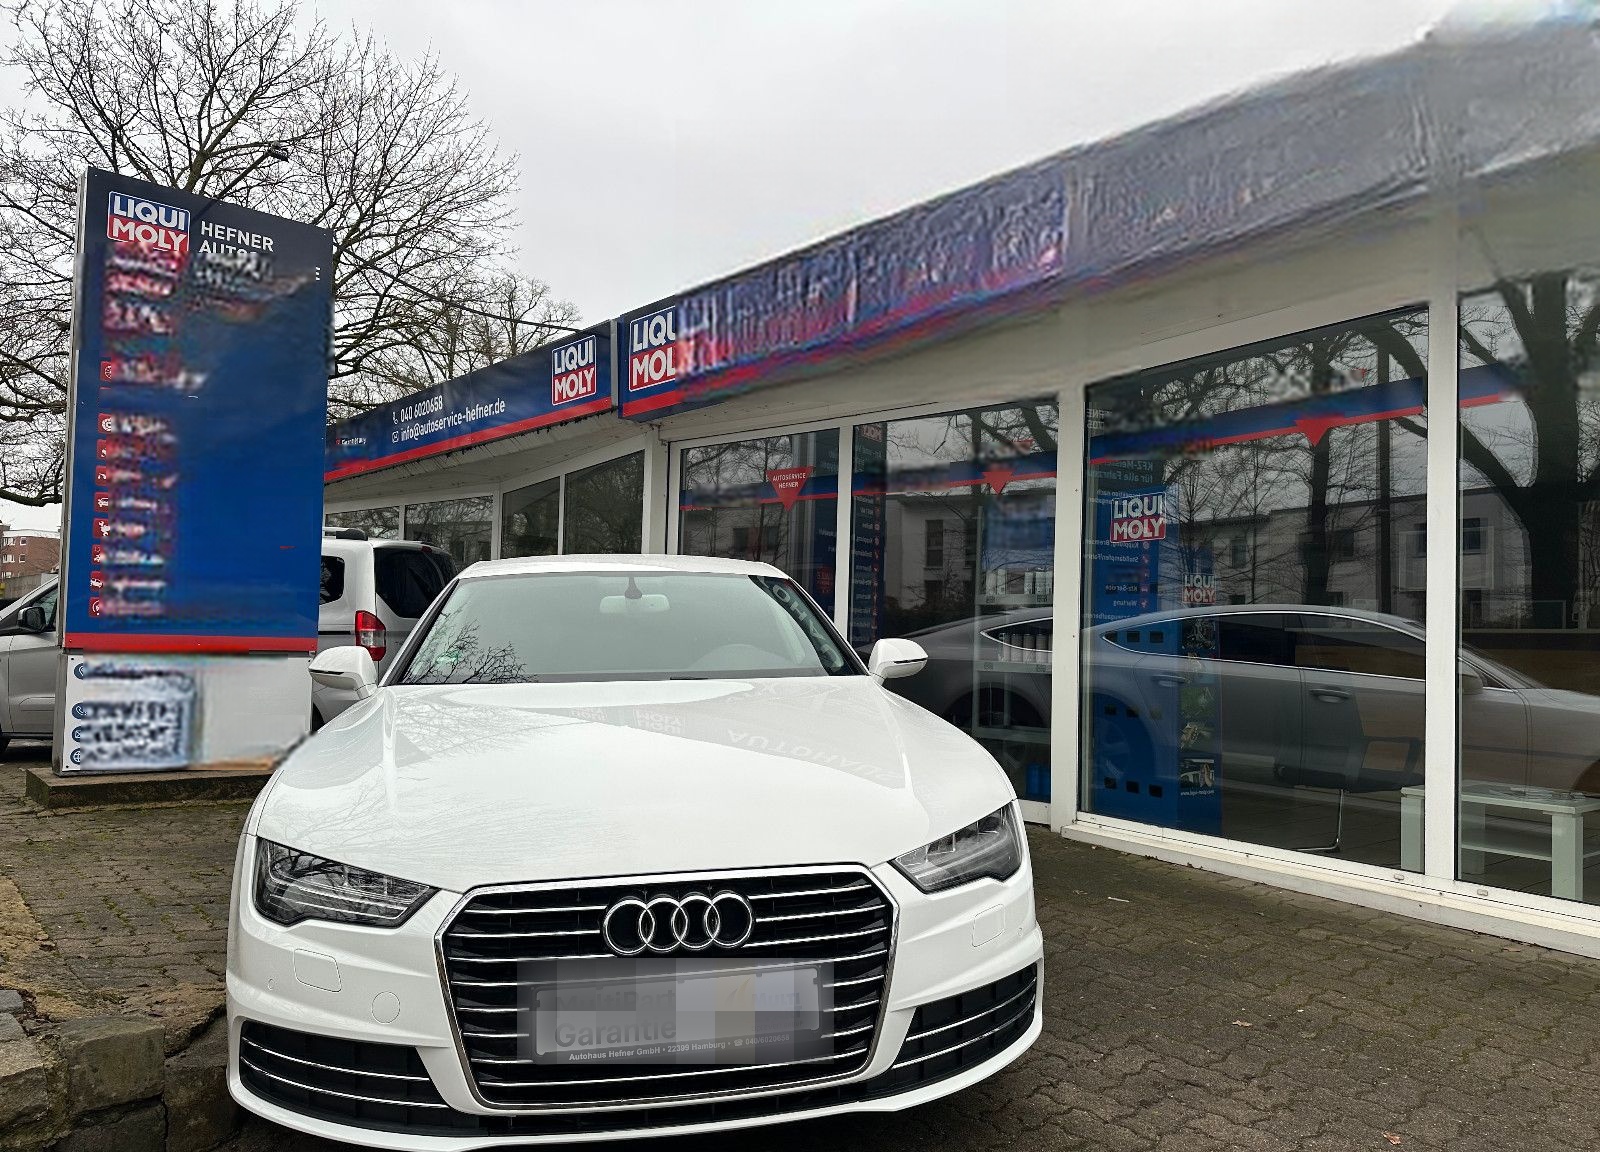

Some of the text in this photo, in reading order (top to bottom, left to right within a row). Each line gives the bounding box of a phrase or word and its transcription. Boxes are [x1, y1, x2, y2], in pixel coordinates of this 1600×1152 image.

[113, 196, 186, 231] LIQUI
[111, 217, 188, 252] MOLY
[200, 221, 274, 252] HEFNER
[554, 339, 594, 374] LIQUI
[554, 367, 595, 402] MOLY
[400, 405, 413, 423] 040
[400, 398, 506, 442] info@autoservice-hefner.de
[772, 472, 806, 482] AUTOSERVICE
[778, 481, 799, 489] HEFNER
[1113, 495, 1163, 519] LIQUI
[1113, 517, 1165, 541] MOLY
[1184, 573, 1215, 589] LIQUI
[1183, 587, 1216, 603] MOLY
[554, 1018, 677, 1048] Garantie
[568, 1051, 607, 1061] Autohaus
[608, 1049, 635, 1059] Hefner
[636, 1047, 661, 1056] GmbH
[667, 1044, 690, 1054] 22399
[691, 1041, 726, 1053] Hamburg
